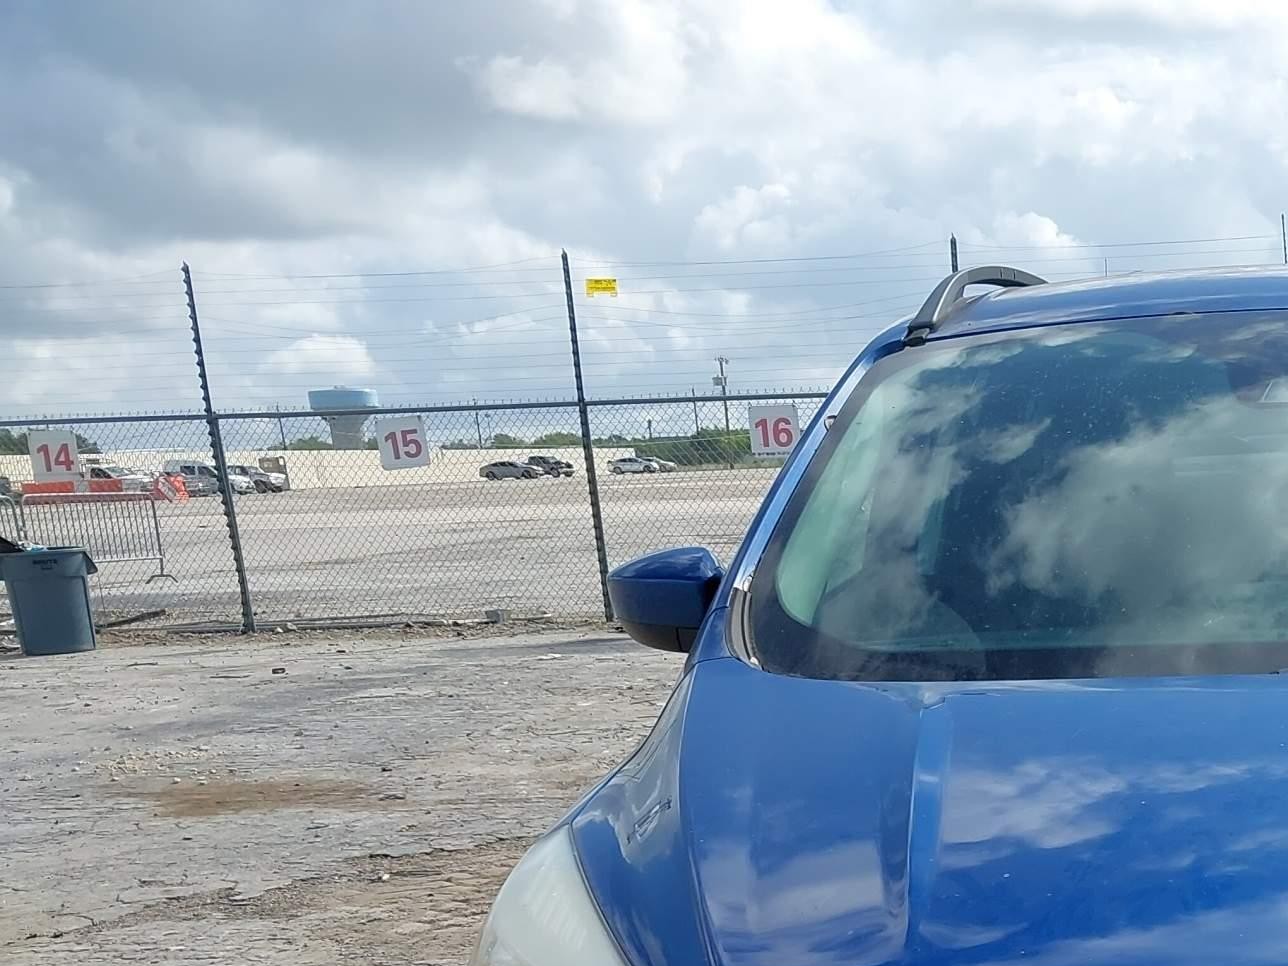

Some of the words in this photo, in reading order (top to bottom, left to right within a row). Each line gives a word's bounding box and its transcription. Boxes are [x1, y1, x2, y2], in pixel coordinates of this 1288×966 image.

[384, 428, 422, 460] 15
[755, 417, 793, 448] 16
[36, 443, 74, 472] 14
